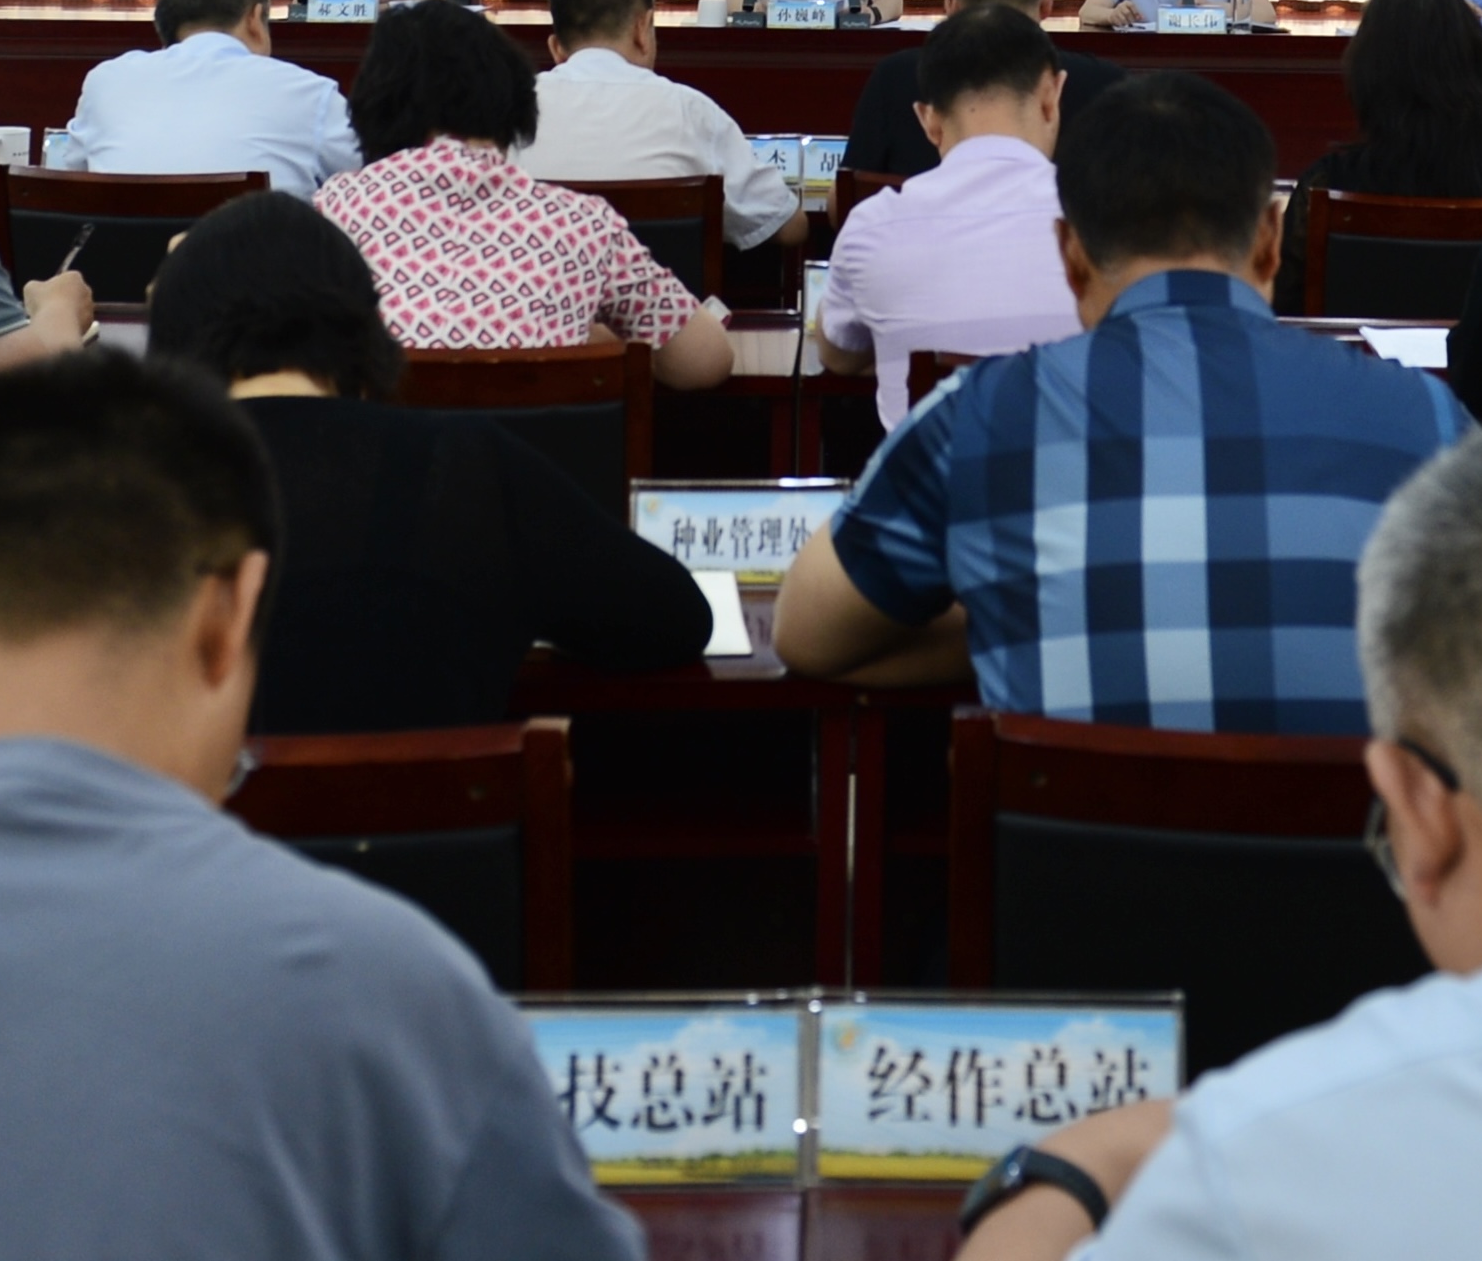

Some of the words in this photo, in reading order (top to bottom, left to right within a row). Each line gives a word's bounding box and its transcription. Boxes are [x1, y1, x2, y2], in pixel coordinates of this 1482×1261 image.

[672, 515, 813, 560] 种业管理处
[866, 1043, 1151, 1127] 经作总站
